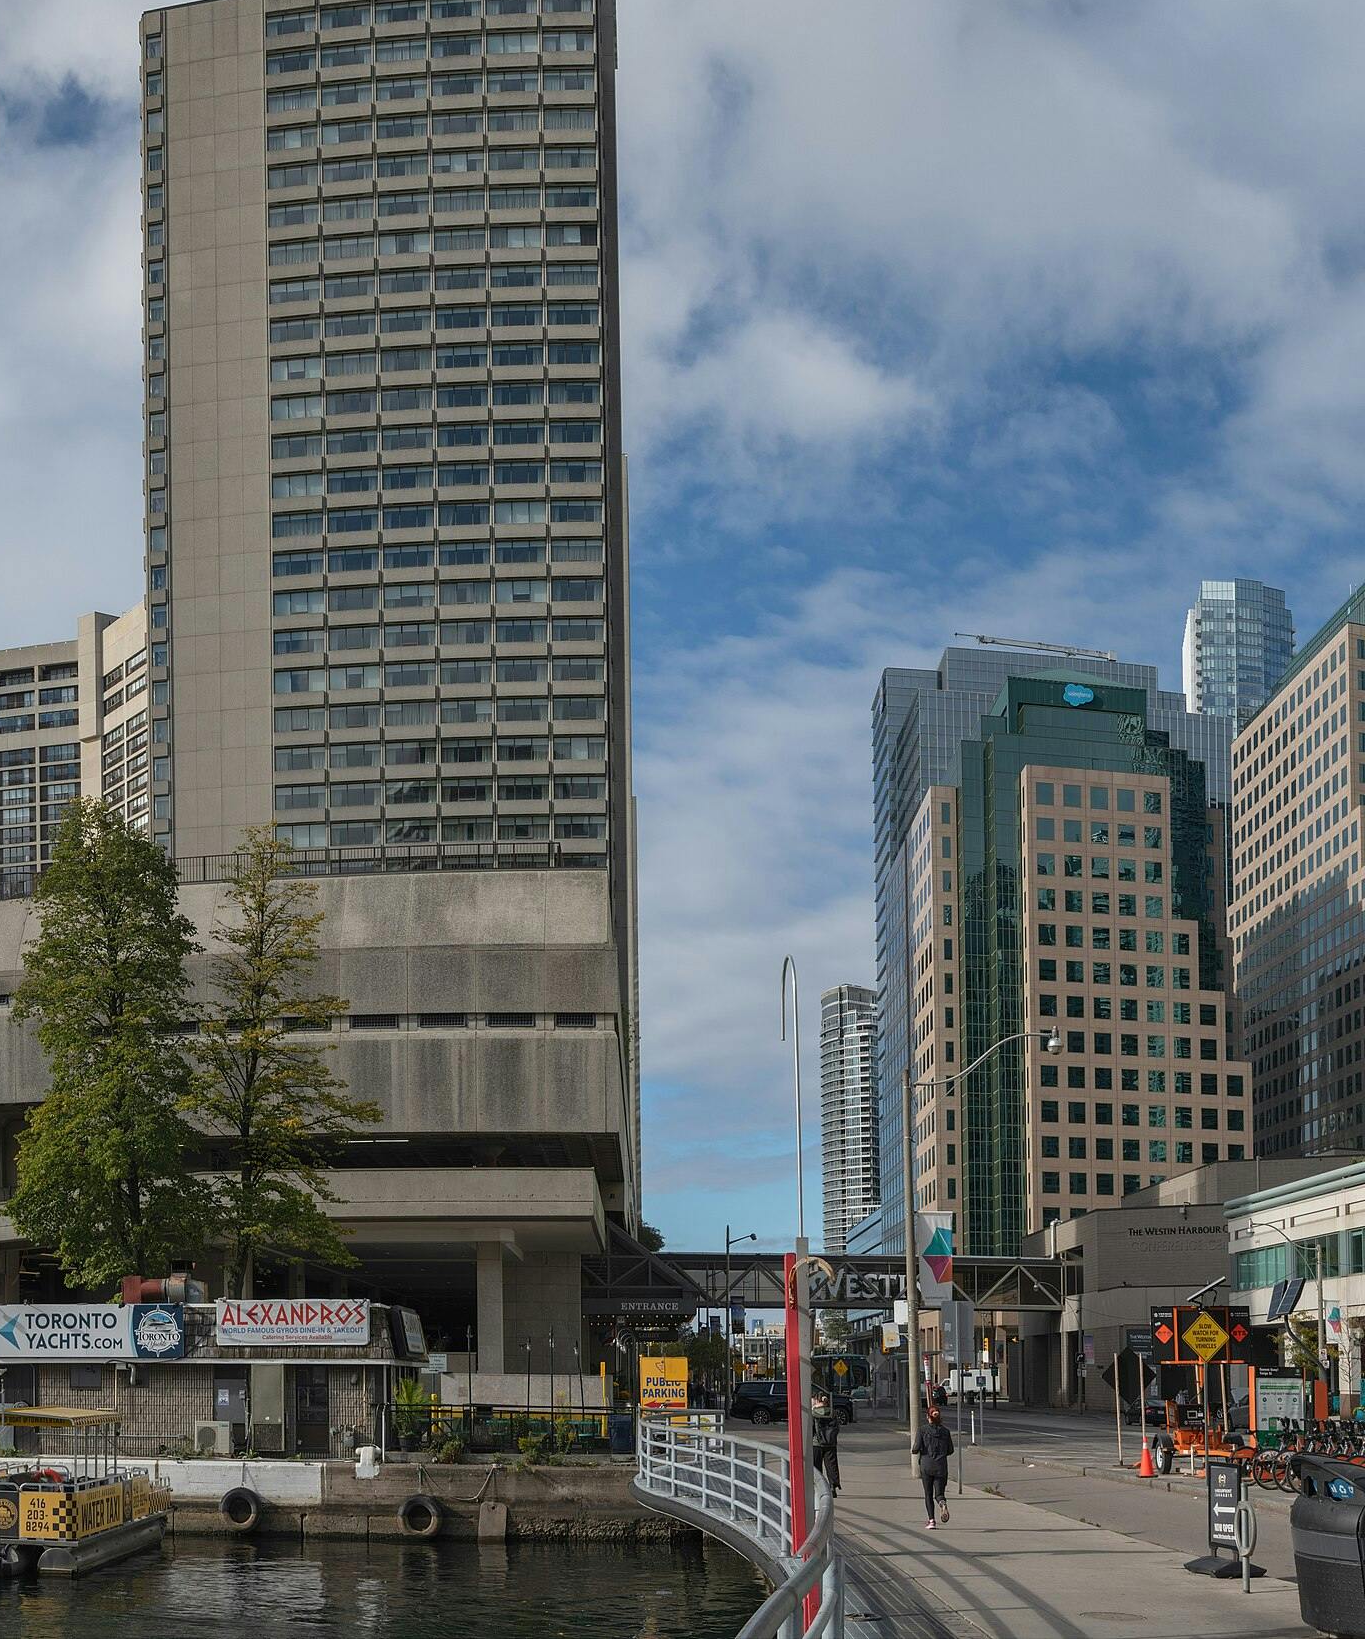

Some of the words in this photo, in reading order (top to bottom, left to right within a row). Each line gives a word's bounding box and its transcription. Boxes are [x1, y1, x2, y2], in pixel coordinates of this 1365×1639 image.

[1128, 1228, 1142, 1236] THE
[1144, 1226, 1176, 1235] WESTIN
[1178, 1225, 1221, 1234] HARBOUR
[621, 1302, 679, 1311] ENTRANCE
[221, 1302, 366, 1326] ALEXANDROS
[25, 1312, 117, 1329] TORONTO
[136, 1331, 180, 1341] TORONTO
[643, 1388, 685, 1398] PARKING
[30, 1498, 46, 1509] 416
[27, 1510, 49, 1520] 203-
[25, 1521, 50, 1532] 8294
